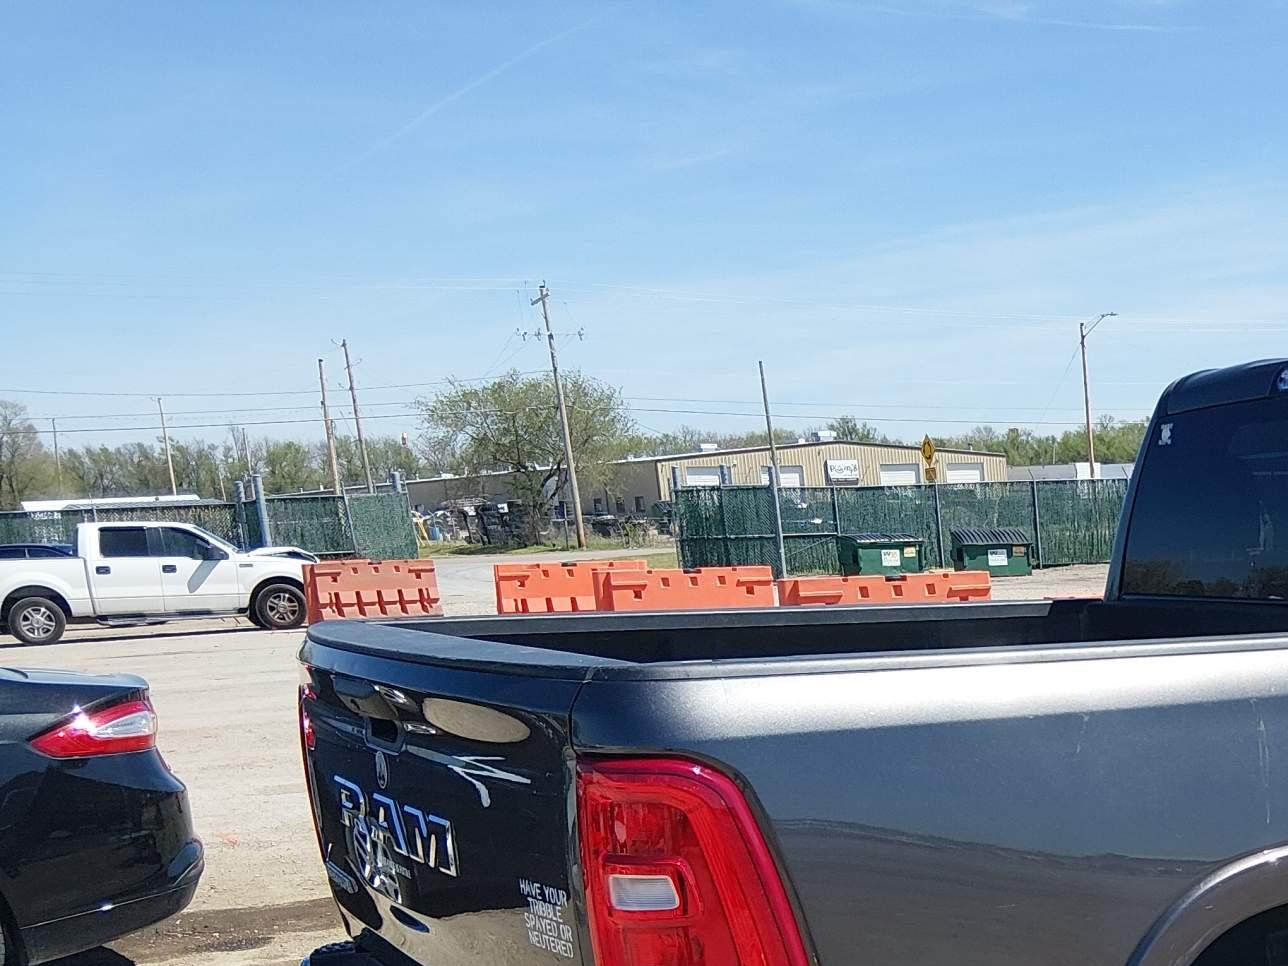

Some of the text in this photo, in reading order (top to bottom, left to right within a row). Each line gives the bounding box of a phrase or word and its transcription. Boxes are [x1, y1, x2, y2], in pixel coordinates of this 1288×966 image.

[334, 774, 460, 877] RAM
[519, 878, 568, 908] HAVE YOUR
[526, 896, 564, 923] TRIBBLE
[524, 912, 573, 942] SPAYED OR
[527, 929, 574, 958] NEUTERED
